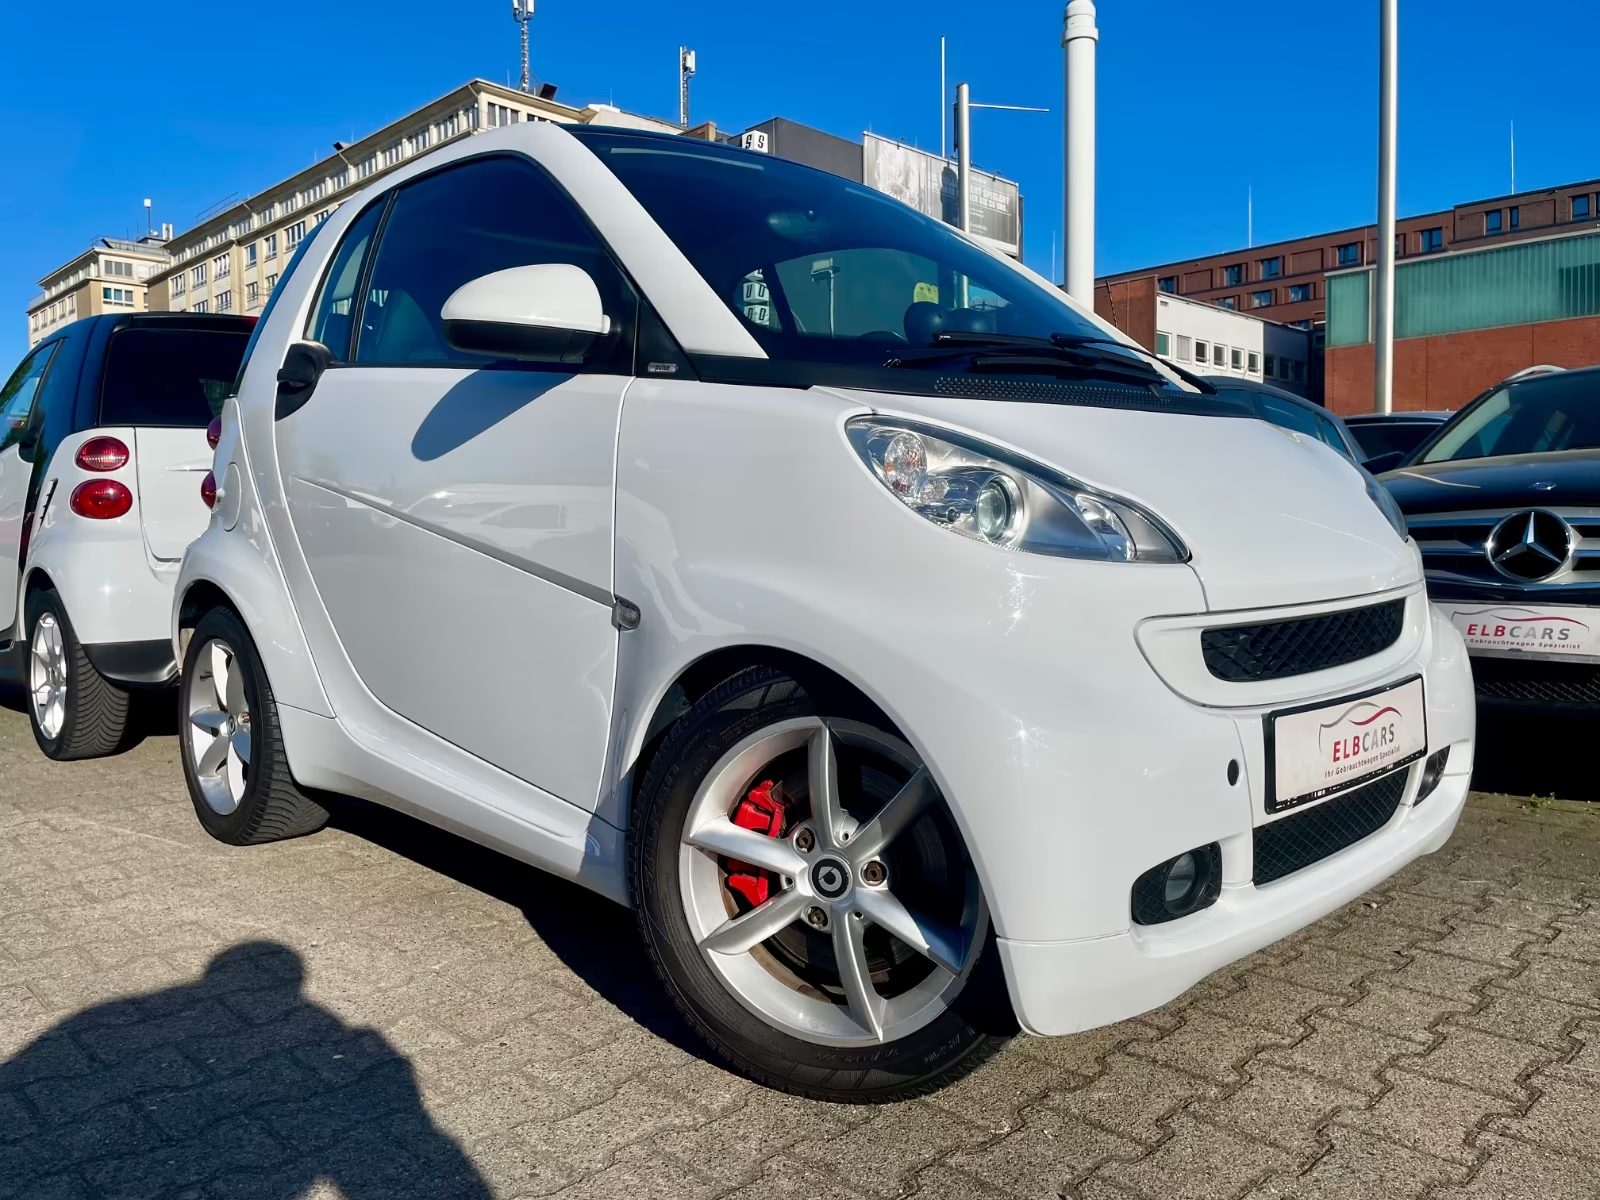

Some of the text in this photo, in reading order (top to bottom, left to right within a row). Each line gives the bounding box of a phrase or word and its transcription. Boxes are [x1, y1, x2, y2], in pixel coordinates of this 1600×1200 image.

[1466, 623, 1571, 641] ELBCARS
[1470, 638, 1536, 648] Gebrauchtwagen
[1538, 642, 1581, 650] Spezialist
[1332, 723, 1396, 763] ELBCARS
[1324, 769, 1335, 779] Ihr
[1335, 754, 1379, 775] Gebrauchtwagen
